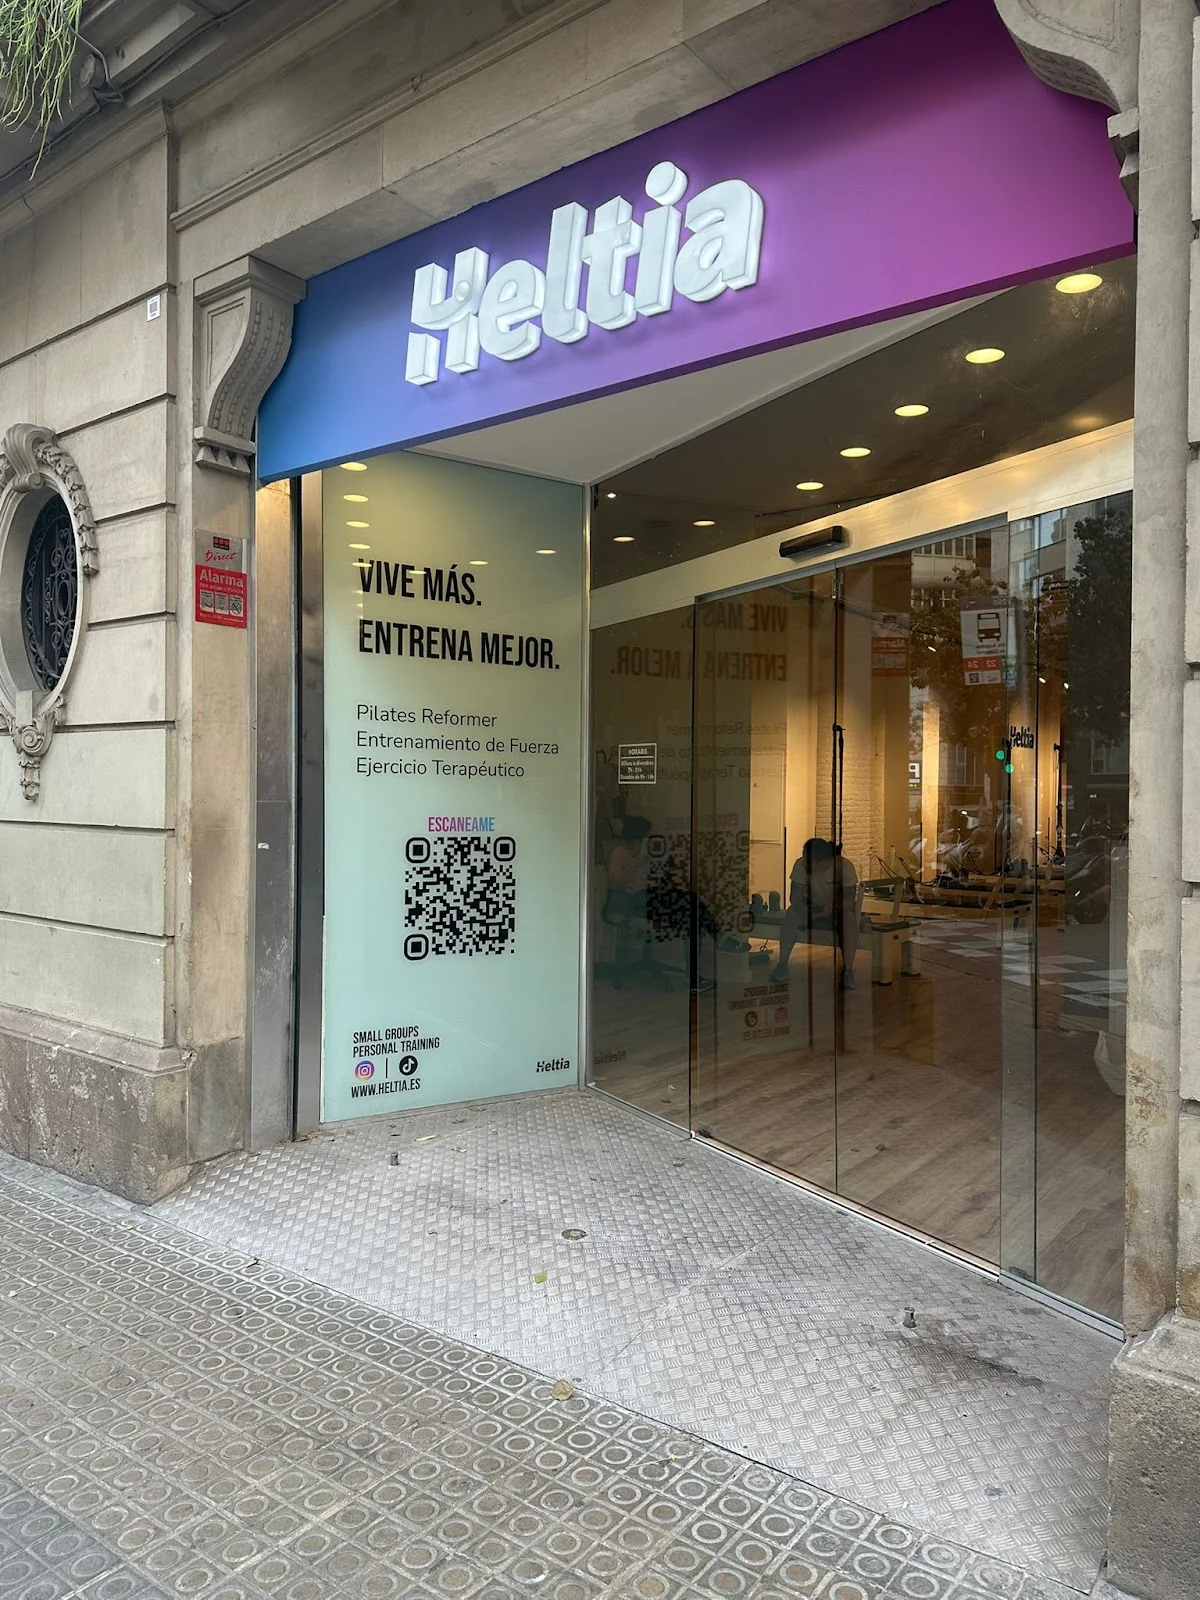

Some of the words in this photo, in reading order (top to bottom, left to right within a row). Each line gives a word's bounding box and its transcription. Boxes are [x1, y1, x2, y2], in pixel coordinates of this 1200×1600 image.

[405, 161, 764, 385] Heltia
[200, 569, 243, 587] Alarma
[358, 558, 415, 598] VIVE
[424, 564, 482, 606] MÁS.
[359, 619, 473, 662] ENTRENA
[481, 632, 561, 669] MEJOR.
[357, 704, 416, 723] Pilates
[423, 708, 497, 728] Reformer
[357, 731, 481, 752] Entrenamiento
[485, 736, 505, 753] de
[510, 738, 559, 755] Fuerza
[356, 757, 427, 778] Ejercicio
[432, 760, 525, 780] Terapéutico
[428, 816, 495, 832] ESCANEAME
[353, 1029, 383, 1044] SMALL
[385, 1025, 419, 1041] GROUPS
[353, 1041, 398, 1058] PERSONAL
[400, 1037, 440, 1052] TRAINING
[536, 1058, 570, 1073] Heltia
[351, 1078, 421, 1098] WWW.HELTIA.ES
